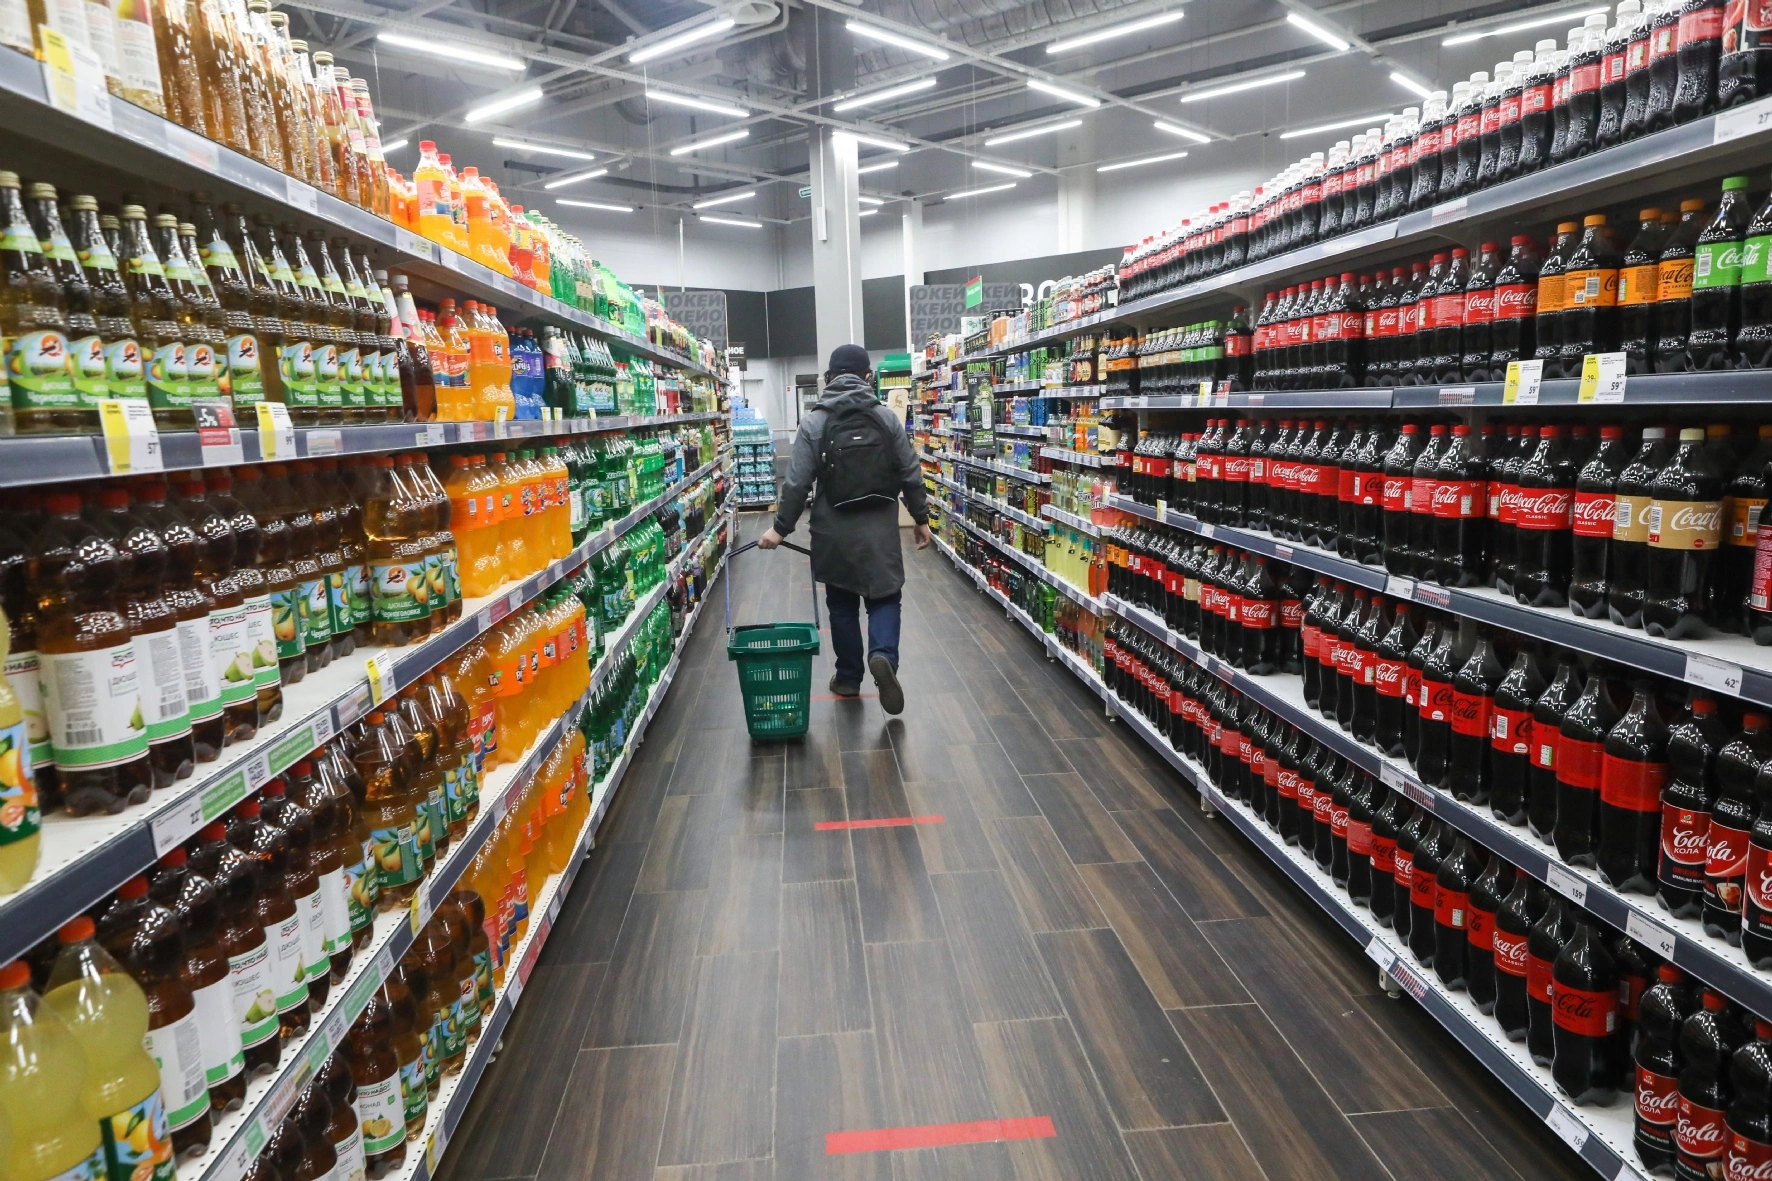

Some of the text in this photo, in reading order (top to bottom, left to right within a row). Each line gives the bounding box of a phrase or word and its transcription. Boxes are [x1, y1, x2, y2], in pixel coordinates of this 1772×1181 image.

[1673, 847, 1700, 855] КОЛА
[1502, 957, 1524, 967] CLASSIC
[1640, 1104, 1661, 1115] КОЛА
[1677, 1112, 1724, 1143] Cola
[1677, 1132, 1697, 1146] КОЛА
